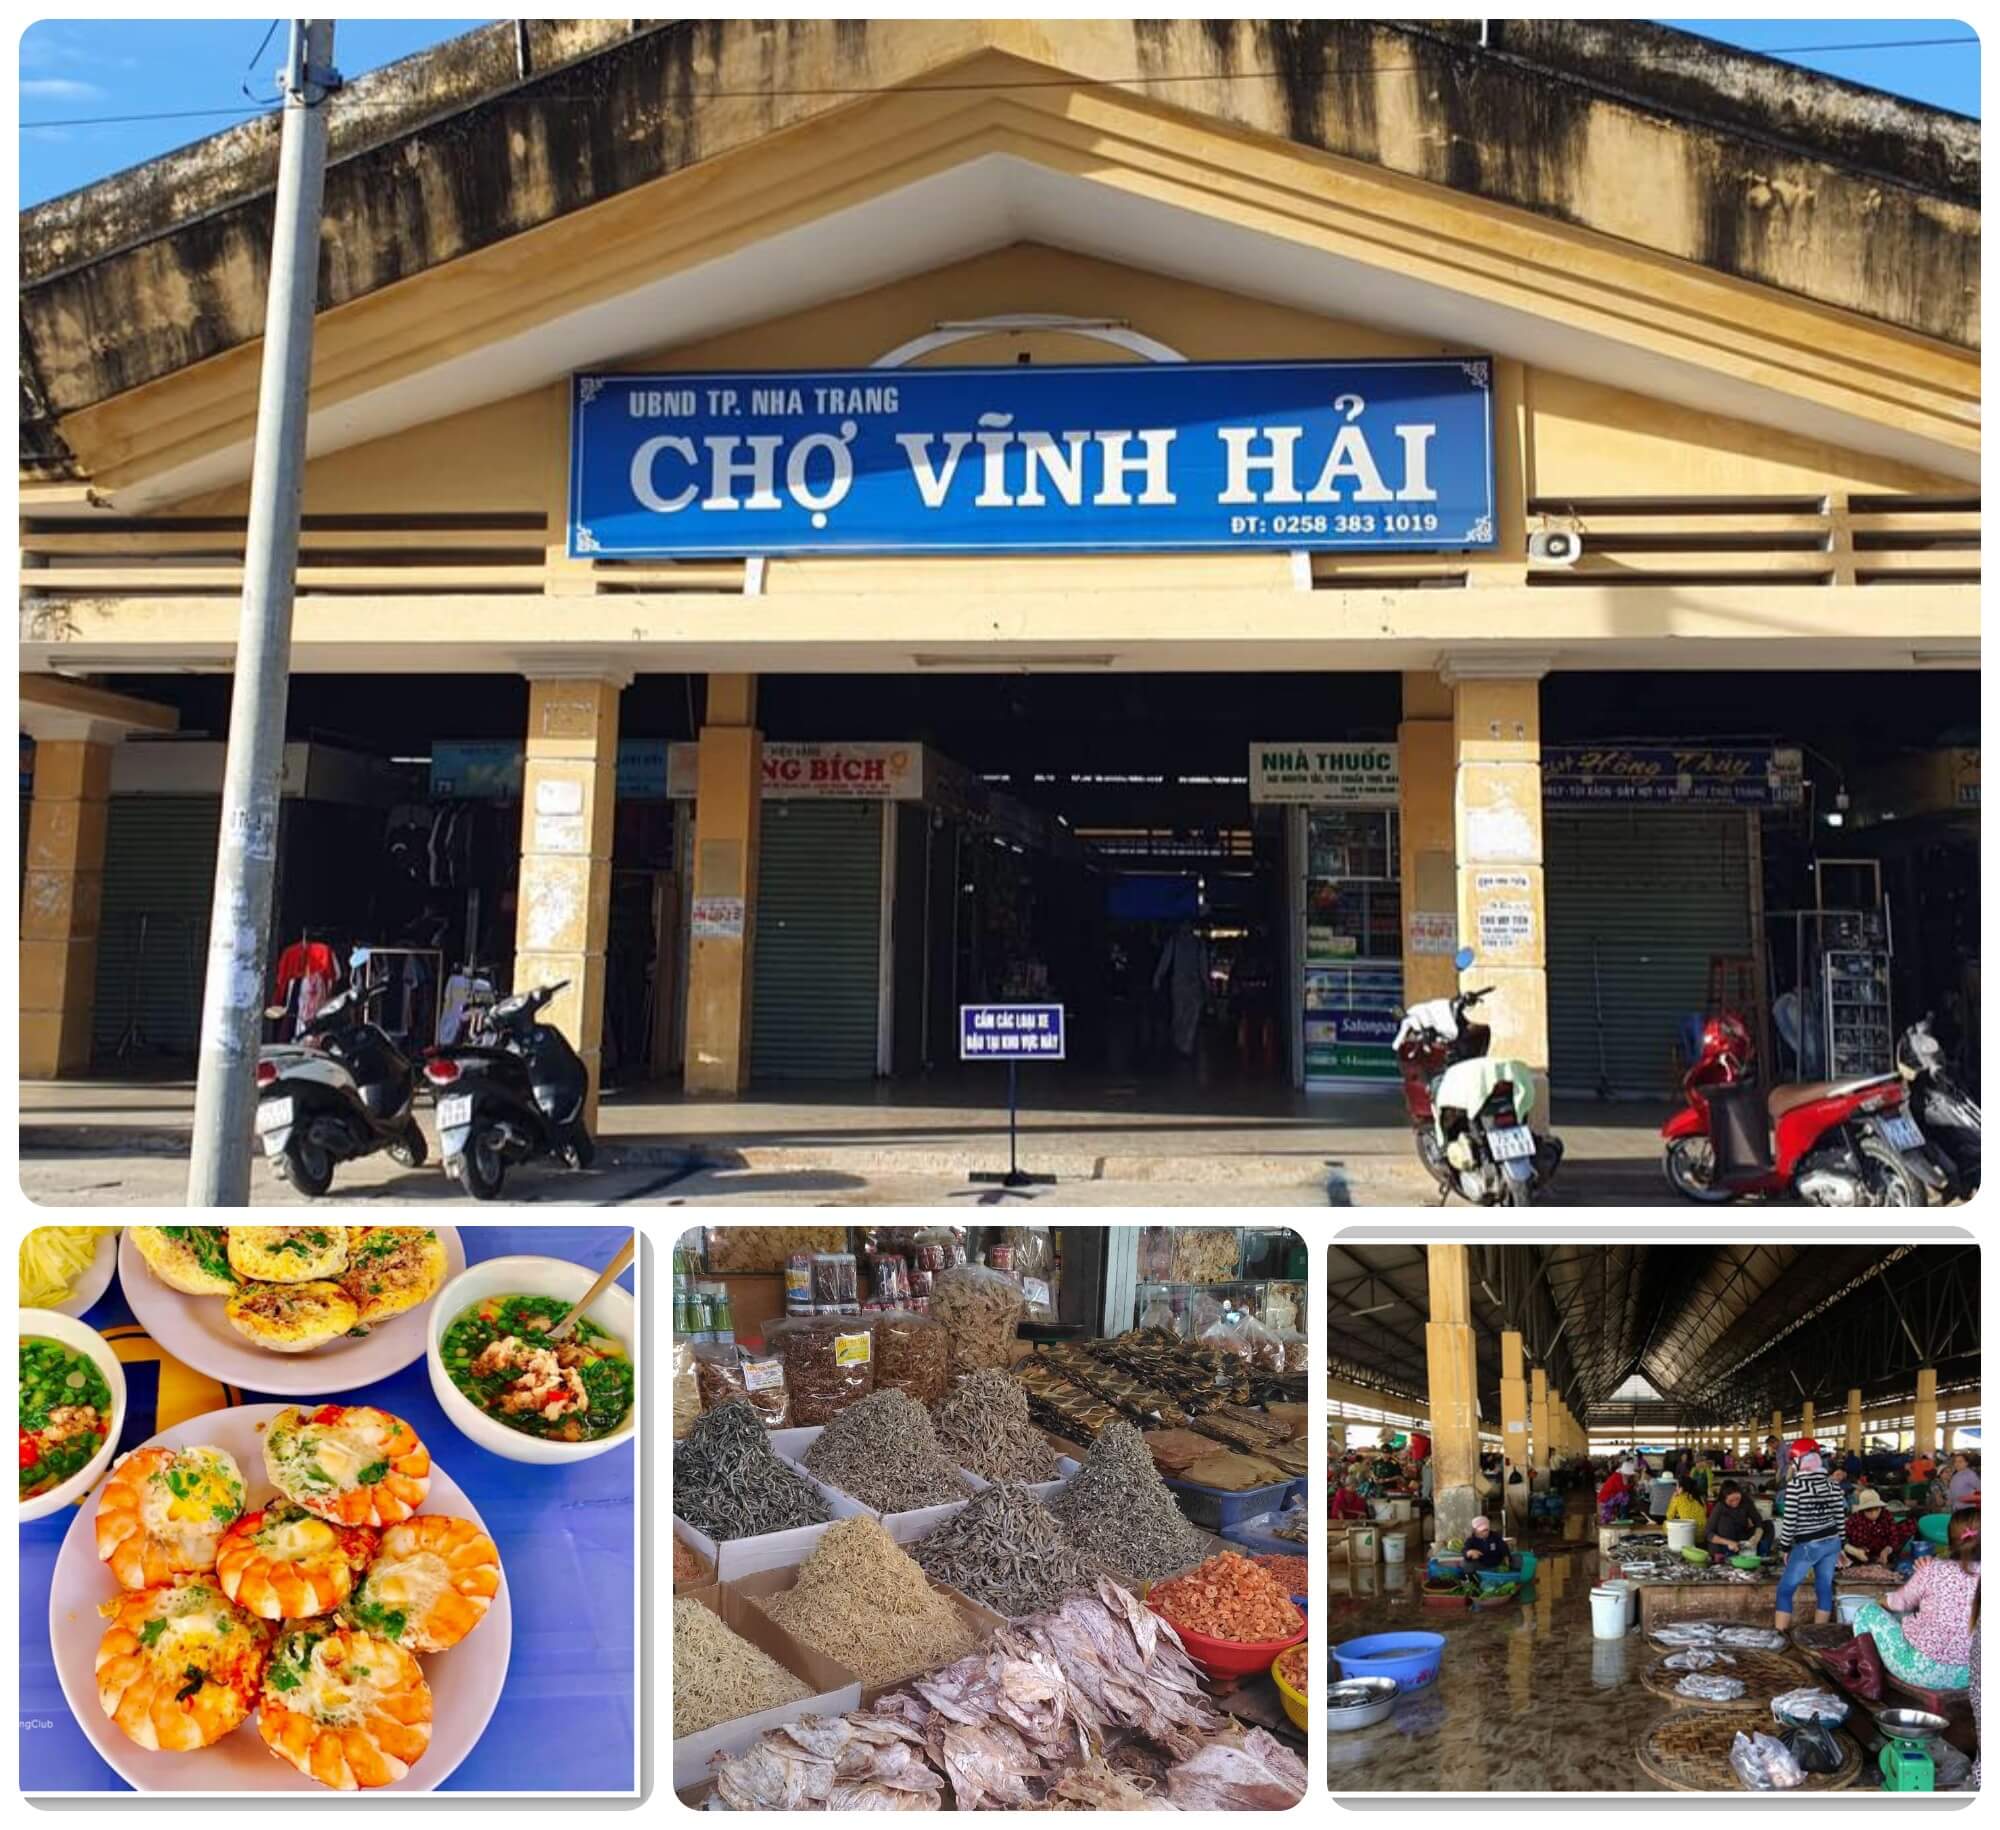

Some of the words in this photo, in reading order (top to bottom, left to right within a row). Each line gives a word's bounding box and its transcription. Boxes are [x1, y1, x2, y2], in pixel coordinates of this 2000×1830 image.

[629, 390, 697, 417] UBND
[707, 390, 742, 416] TP.
[752, 388, 804, 416] NHA
[814, 387, 899, 415] TRANG
[629, 420, 858, 529] CHỢ
[896, 411, 1177, 507] VĨNH
[1218, 394, 1437, 504] HẢI
[1230, 515, 1267, 534] ĐT:
[1273, 514, 1327, 533] 0258
[1334, 514, 1375, 533] 383
[1384, 513, 1438, 532] 1019
[809, 753, 887, 781] BÍCH
[1261, 748, 1309, 771] NHÀ
[1315, 747, 1391, 771] THUỐC
